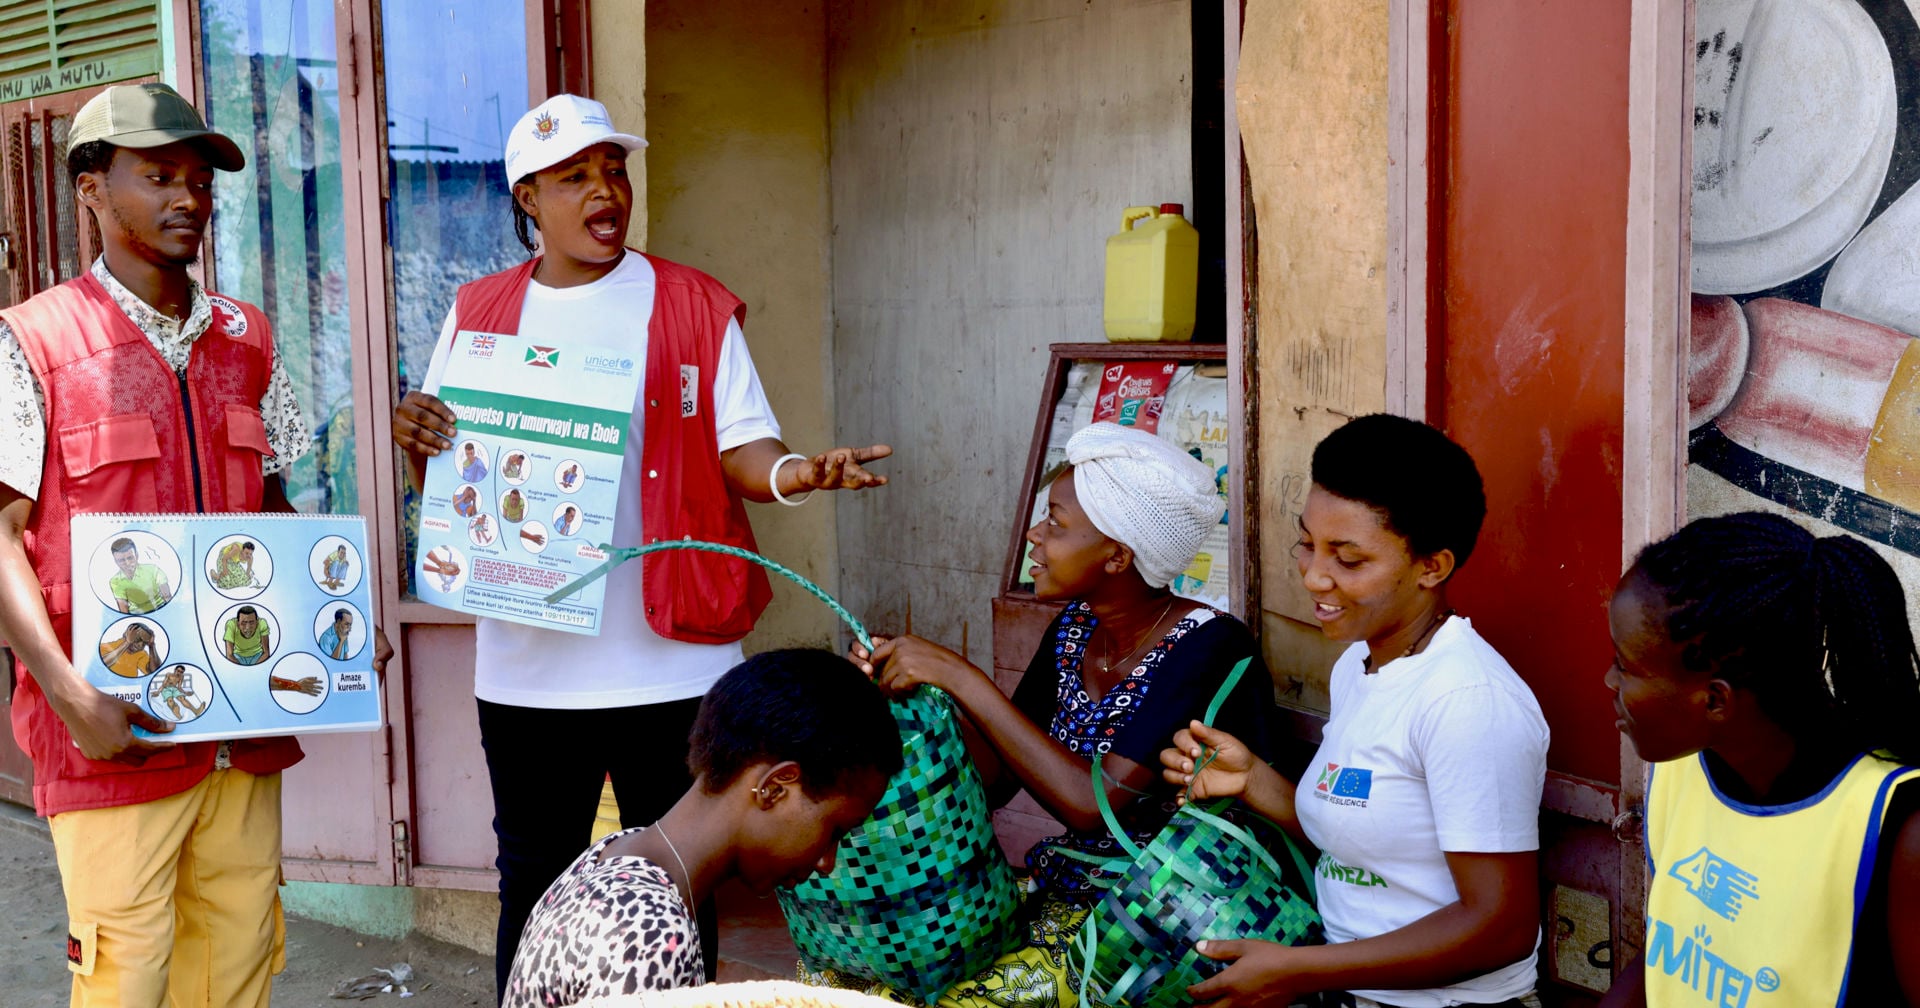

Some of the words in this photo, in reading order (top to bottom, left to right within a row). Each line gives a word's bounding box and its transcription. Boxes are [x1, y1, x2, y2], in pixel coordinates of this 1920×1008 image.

[31, 75, 52, 94] WA
[61, 61, 111, 86] MUTU.
[211, 298, 241, 316] ROUGE
[585, 356, 620, 368] unicef
[1118, 375, 1132, 398] 6
[506, 411, 572, 439] vy'umurwayi
[573, 422, 590, 440] wa
[590, 422, 620, 445] Ebola
[475, 559, 516, 569] GUKARABA
[484, 578, 509, 586] EBOLA
[544, 611, 585, 624] 109/113/117
[340, 672, 362, 682] Amaze
[337, 682, 367, 692] kuremba
